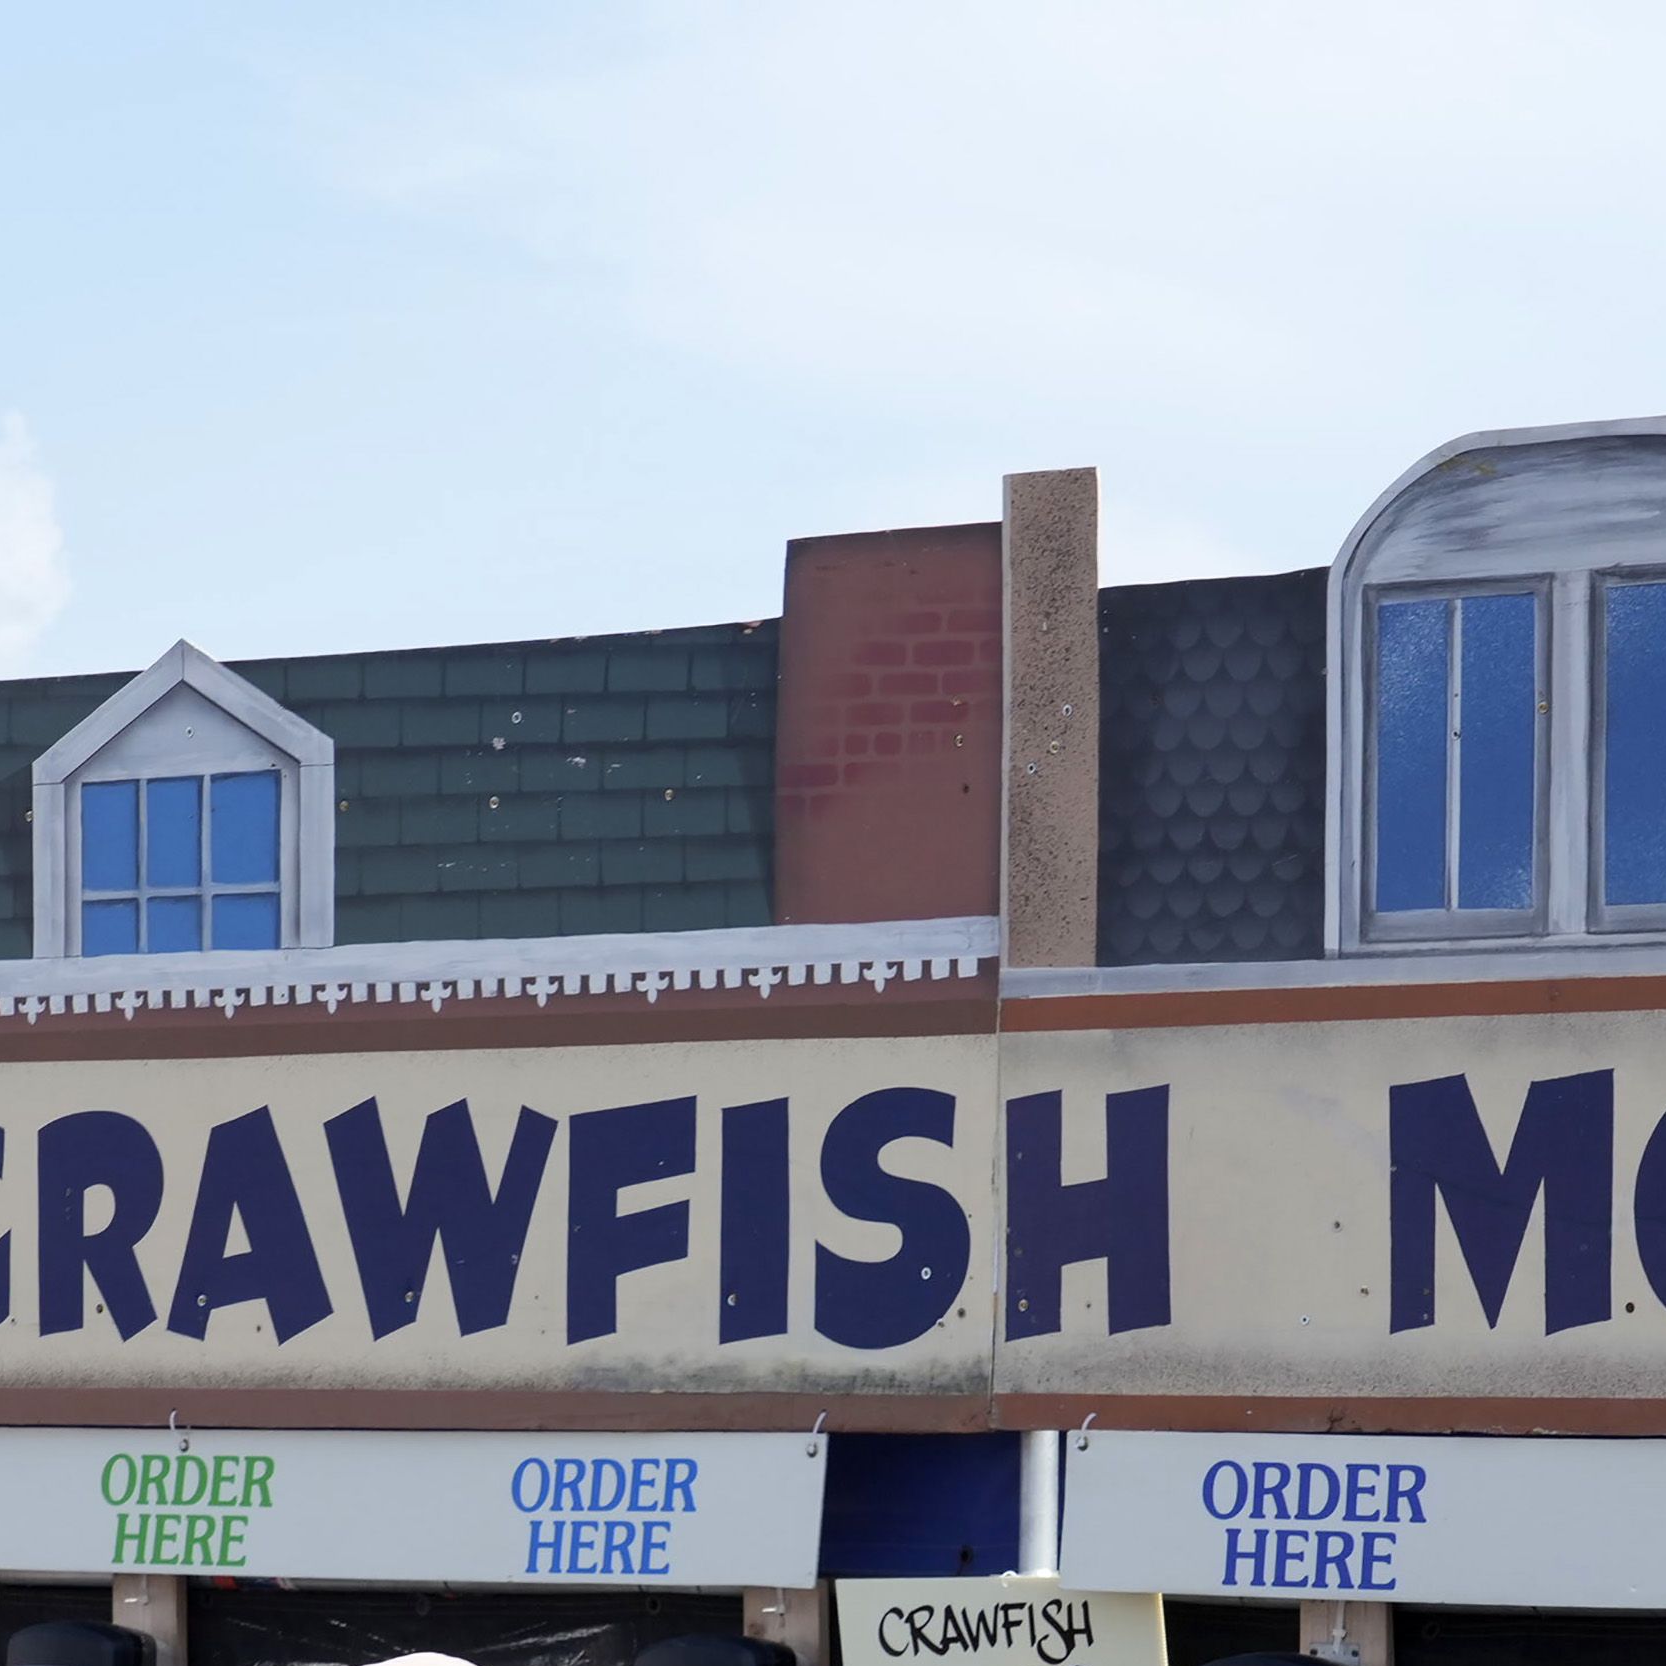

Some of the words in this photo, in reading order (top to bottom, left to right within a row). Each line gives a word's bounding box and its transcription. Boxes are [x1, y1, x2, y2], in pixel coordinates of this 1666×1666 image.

[102, 1445, 274, 1507] ORDER
[512, 1458, 698, 1512] ORDER
[1202, 1460, 1427, 1523] ORDER
[112, 1514, 248, 1566] HERE
[525, 1520, 671, 1574] HERE
[1222, 1528, 1396, 1590] HERE
[878, 1598, 1094, 1665] CRAWFISH
